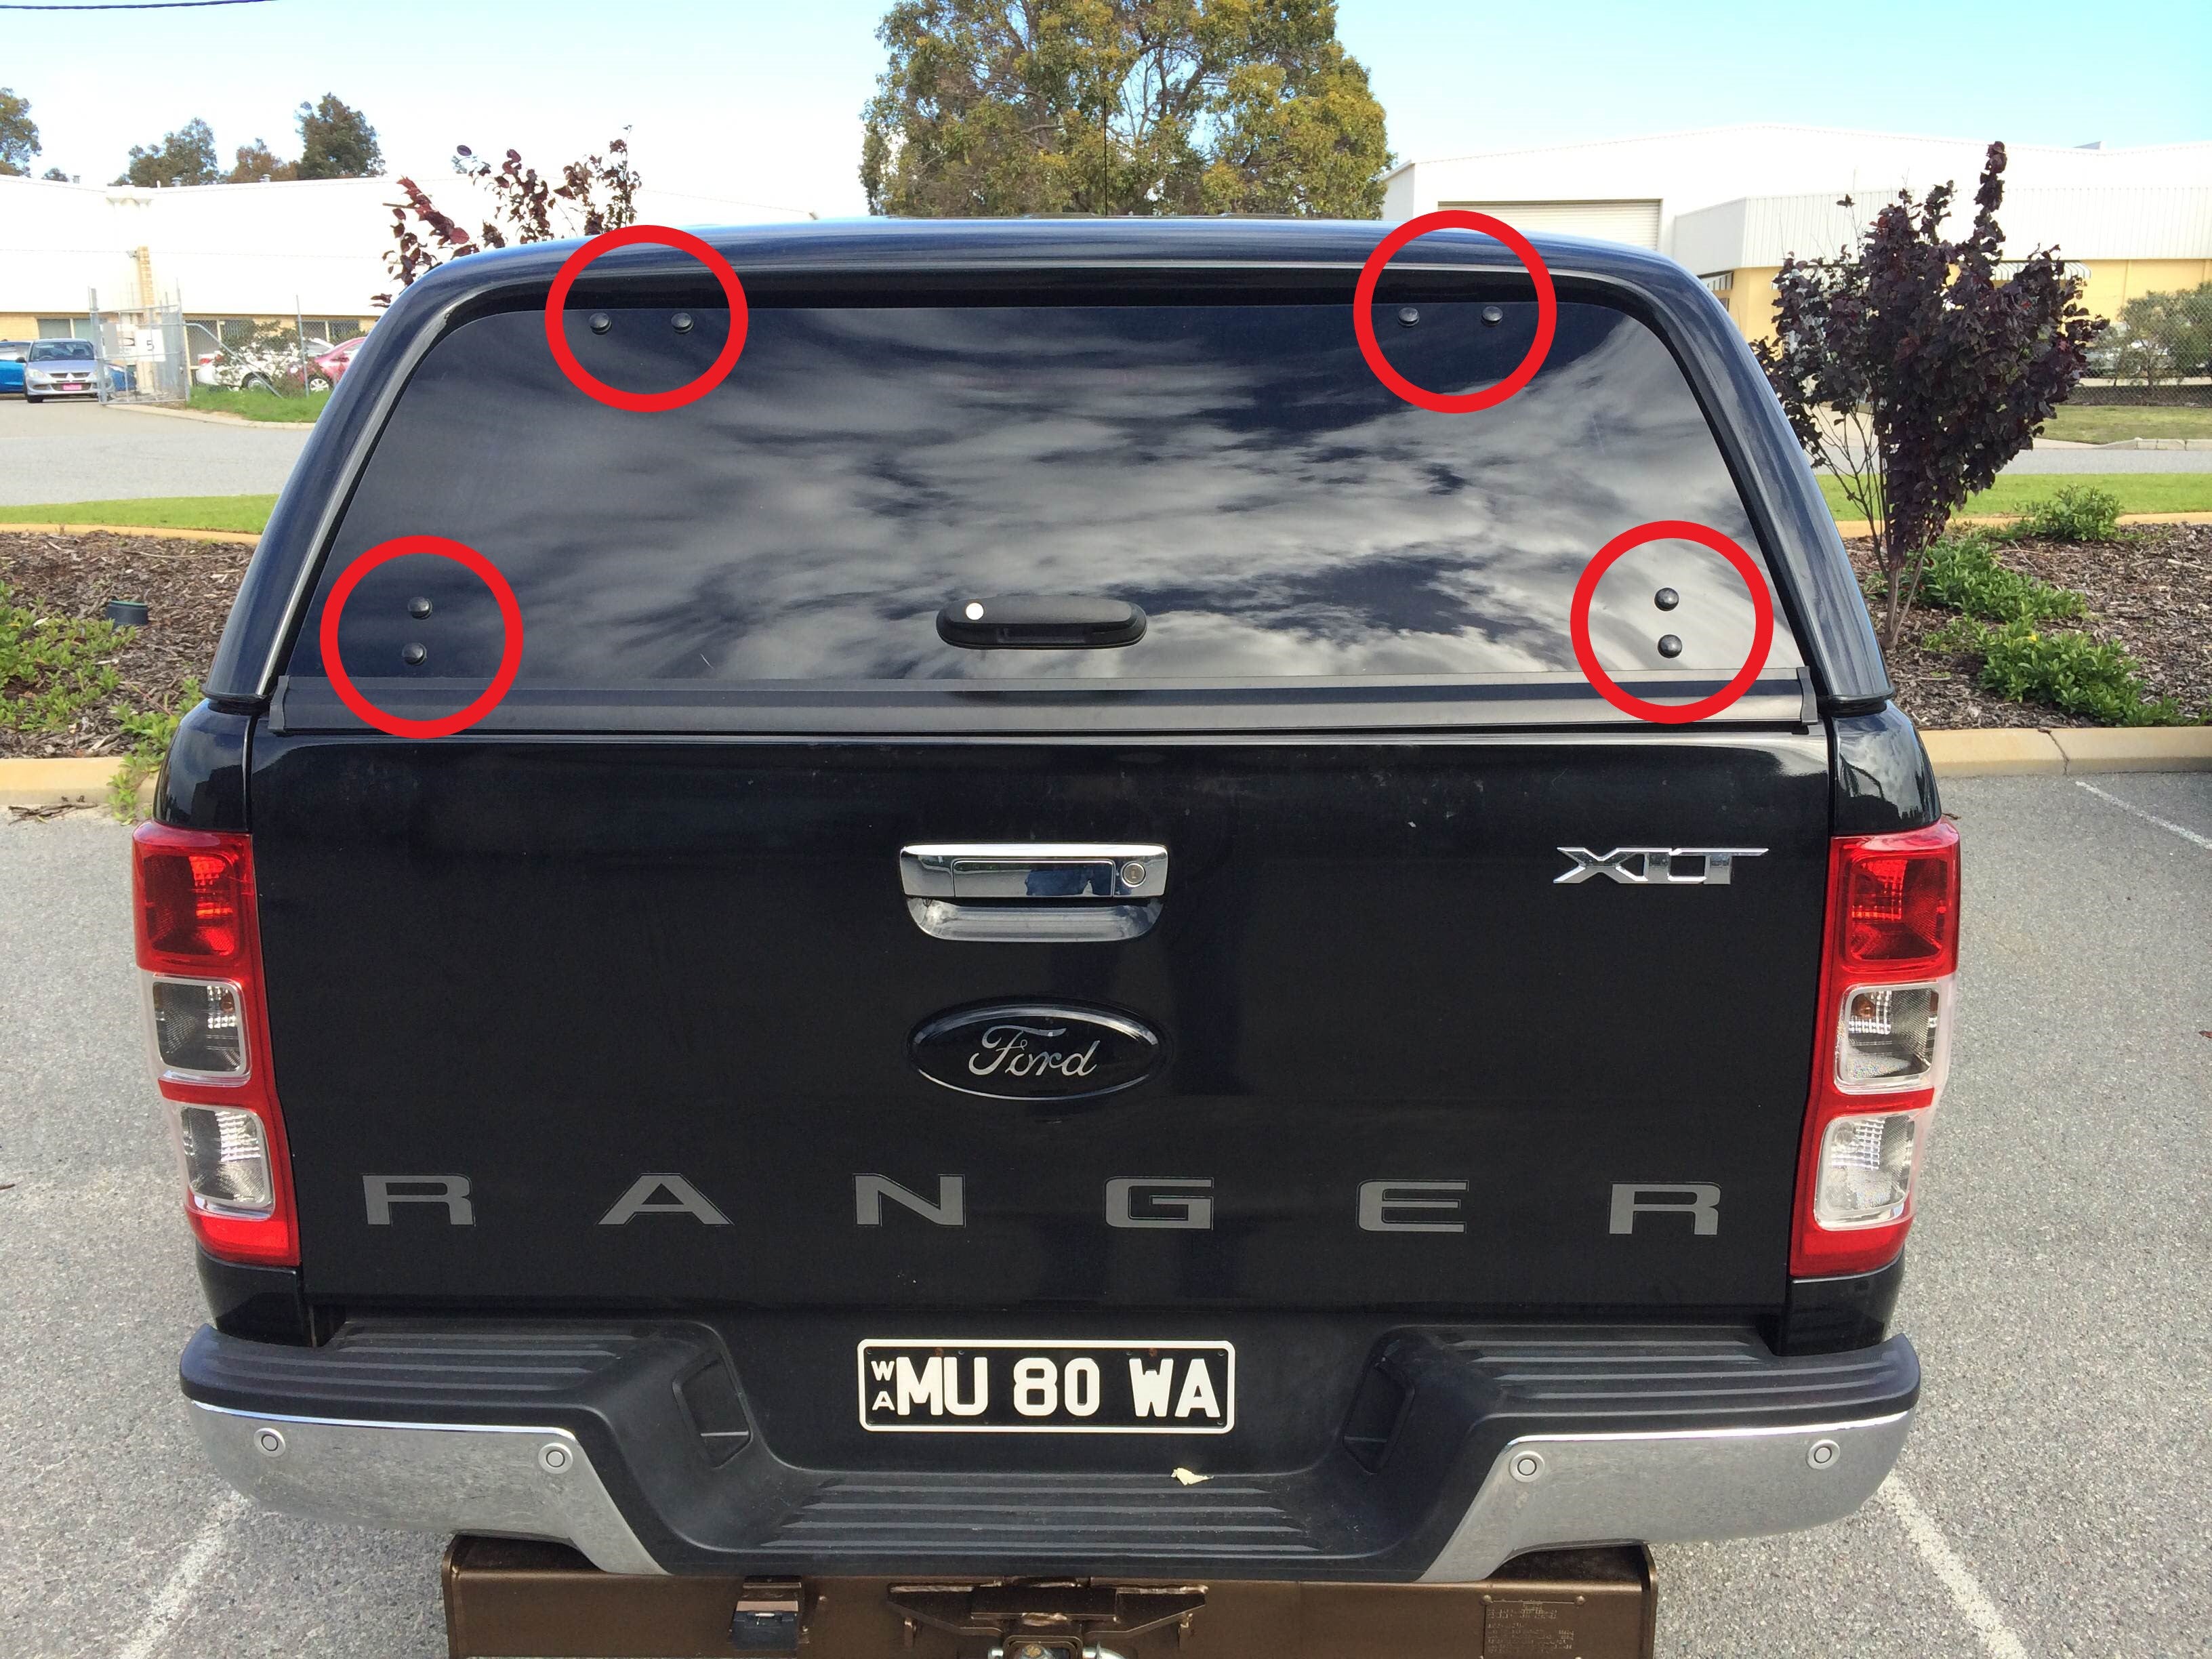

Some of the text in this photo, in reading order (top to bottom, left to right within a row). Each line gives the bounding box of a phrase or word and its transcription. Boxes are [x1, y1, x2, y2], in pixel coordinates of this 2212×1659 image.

[1553, 847, 1769, 884] XLT
[968, 1025, 1101, 1076] Ford
[362, 1172, 1722, 1235] RANGER
[896, 1357, 1221, 1418] MU 80 WA
